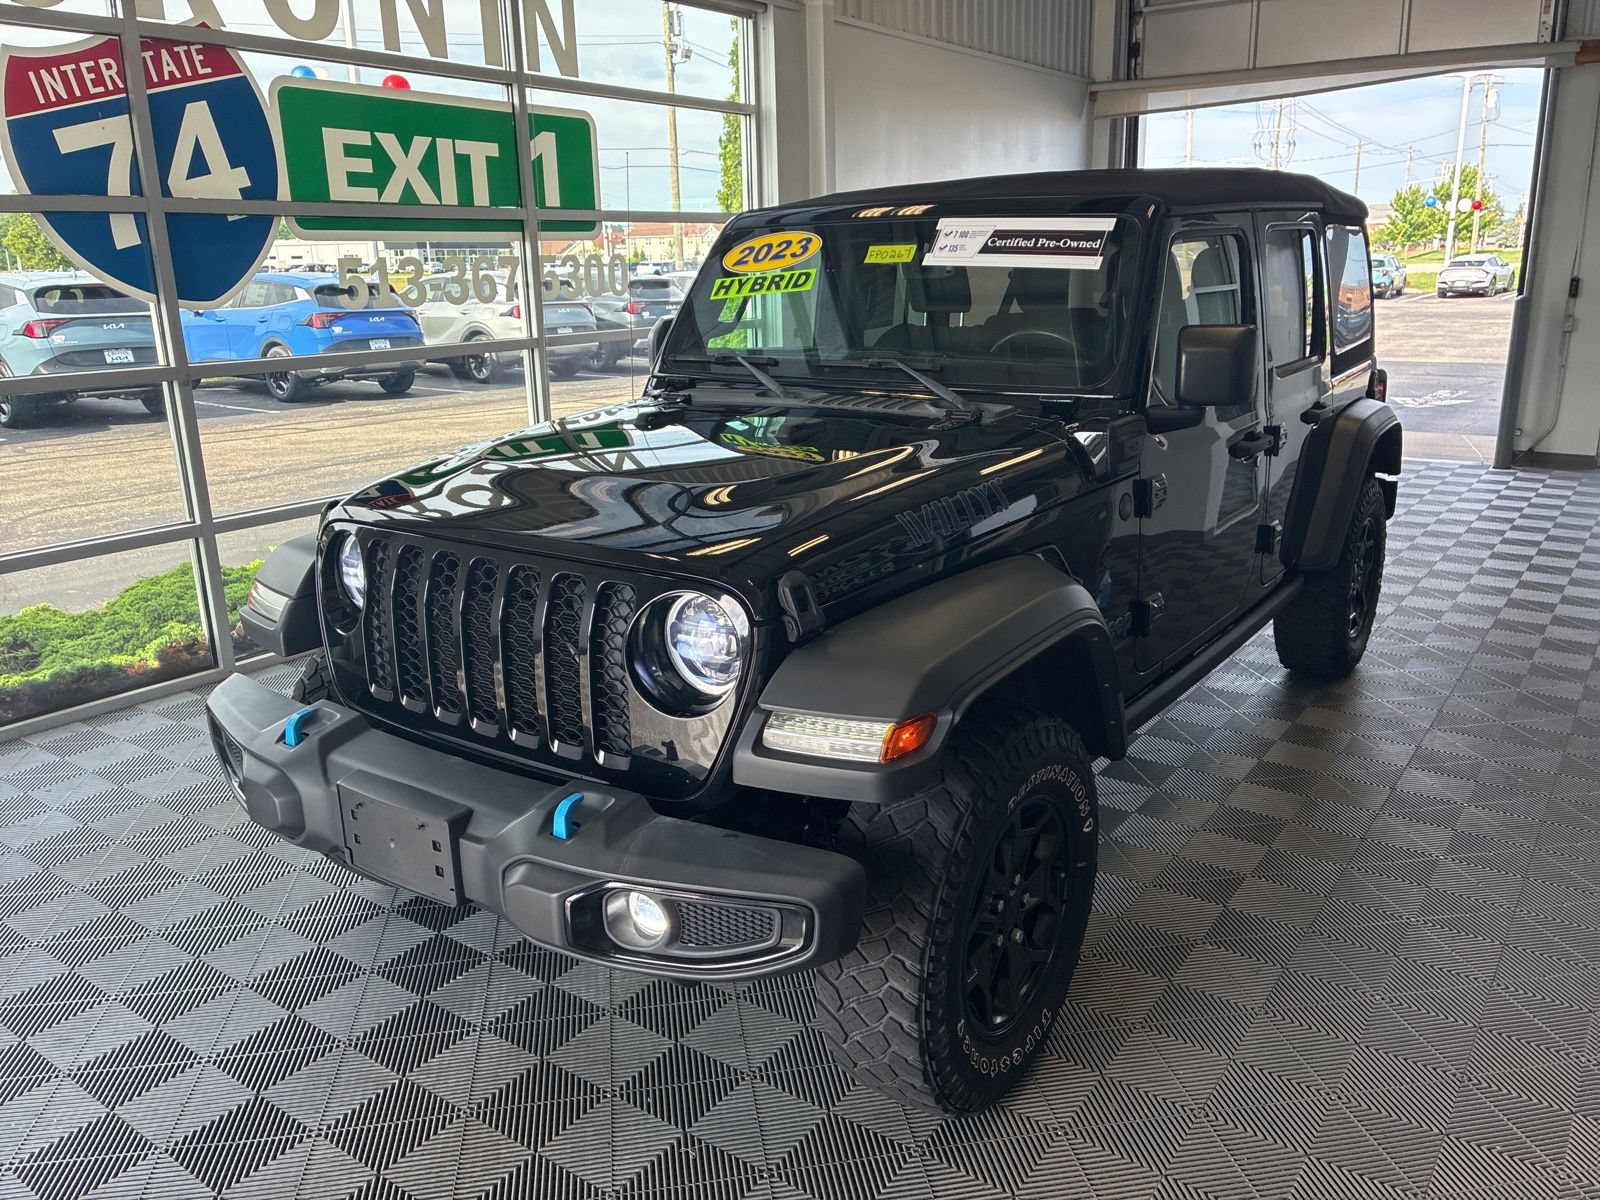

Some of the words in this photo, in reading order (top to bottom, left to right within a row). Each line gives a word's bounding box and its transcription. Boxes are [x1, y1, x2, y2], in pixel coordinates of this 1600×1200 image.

[28, 44, 212, 104] INTERTATE
[52, 100, 251, 250] 74
[321, 127, 499, 207] EXIT
[529, 131, 561, 207] 1
[732, 237, 813, 267] 2023
[987, 237, 1034, 247] Certified
[1036, 238, 1101, 248] Pre-Owned
[337, 253, 629, 310] 513-3675300
[713, 271, 812, 297] HYBRID
